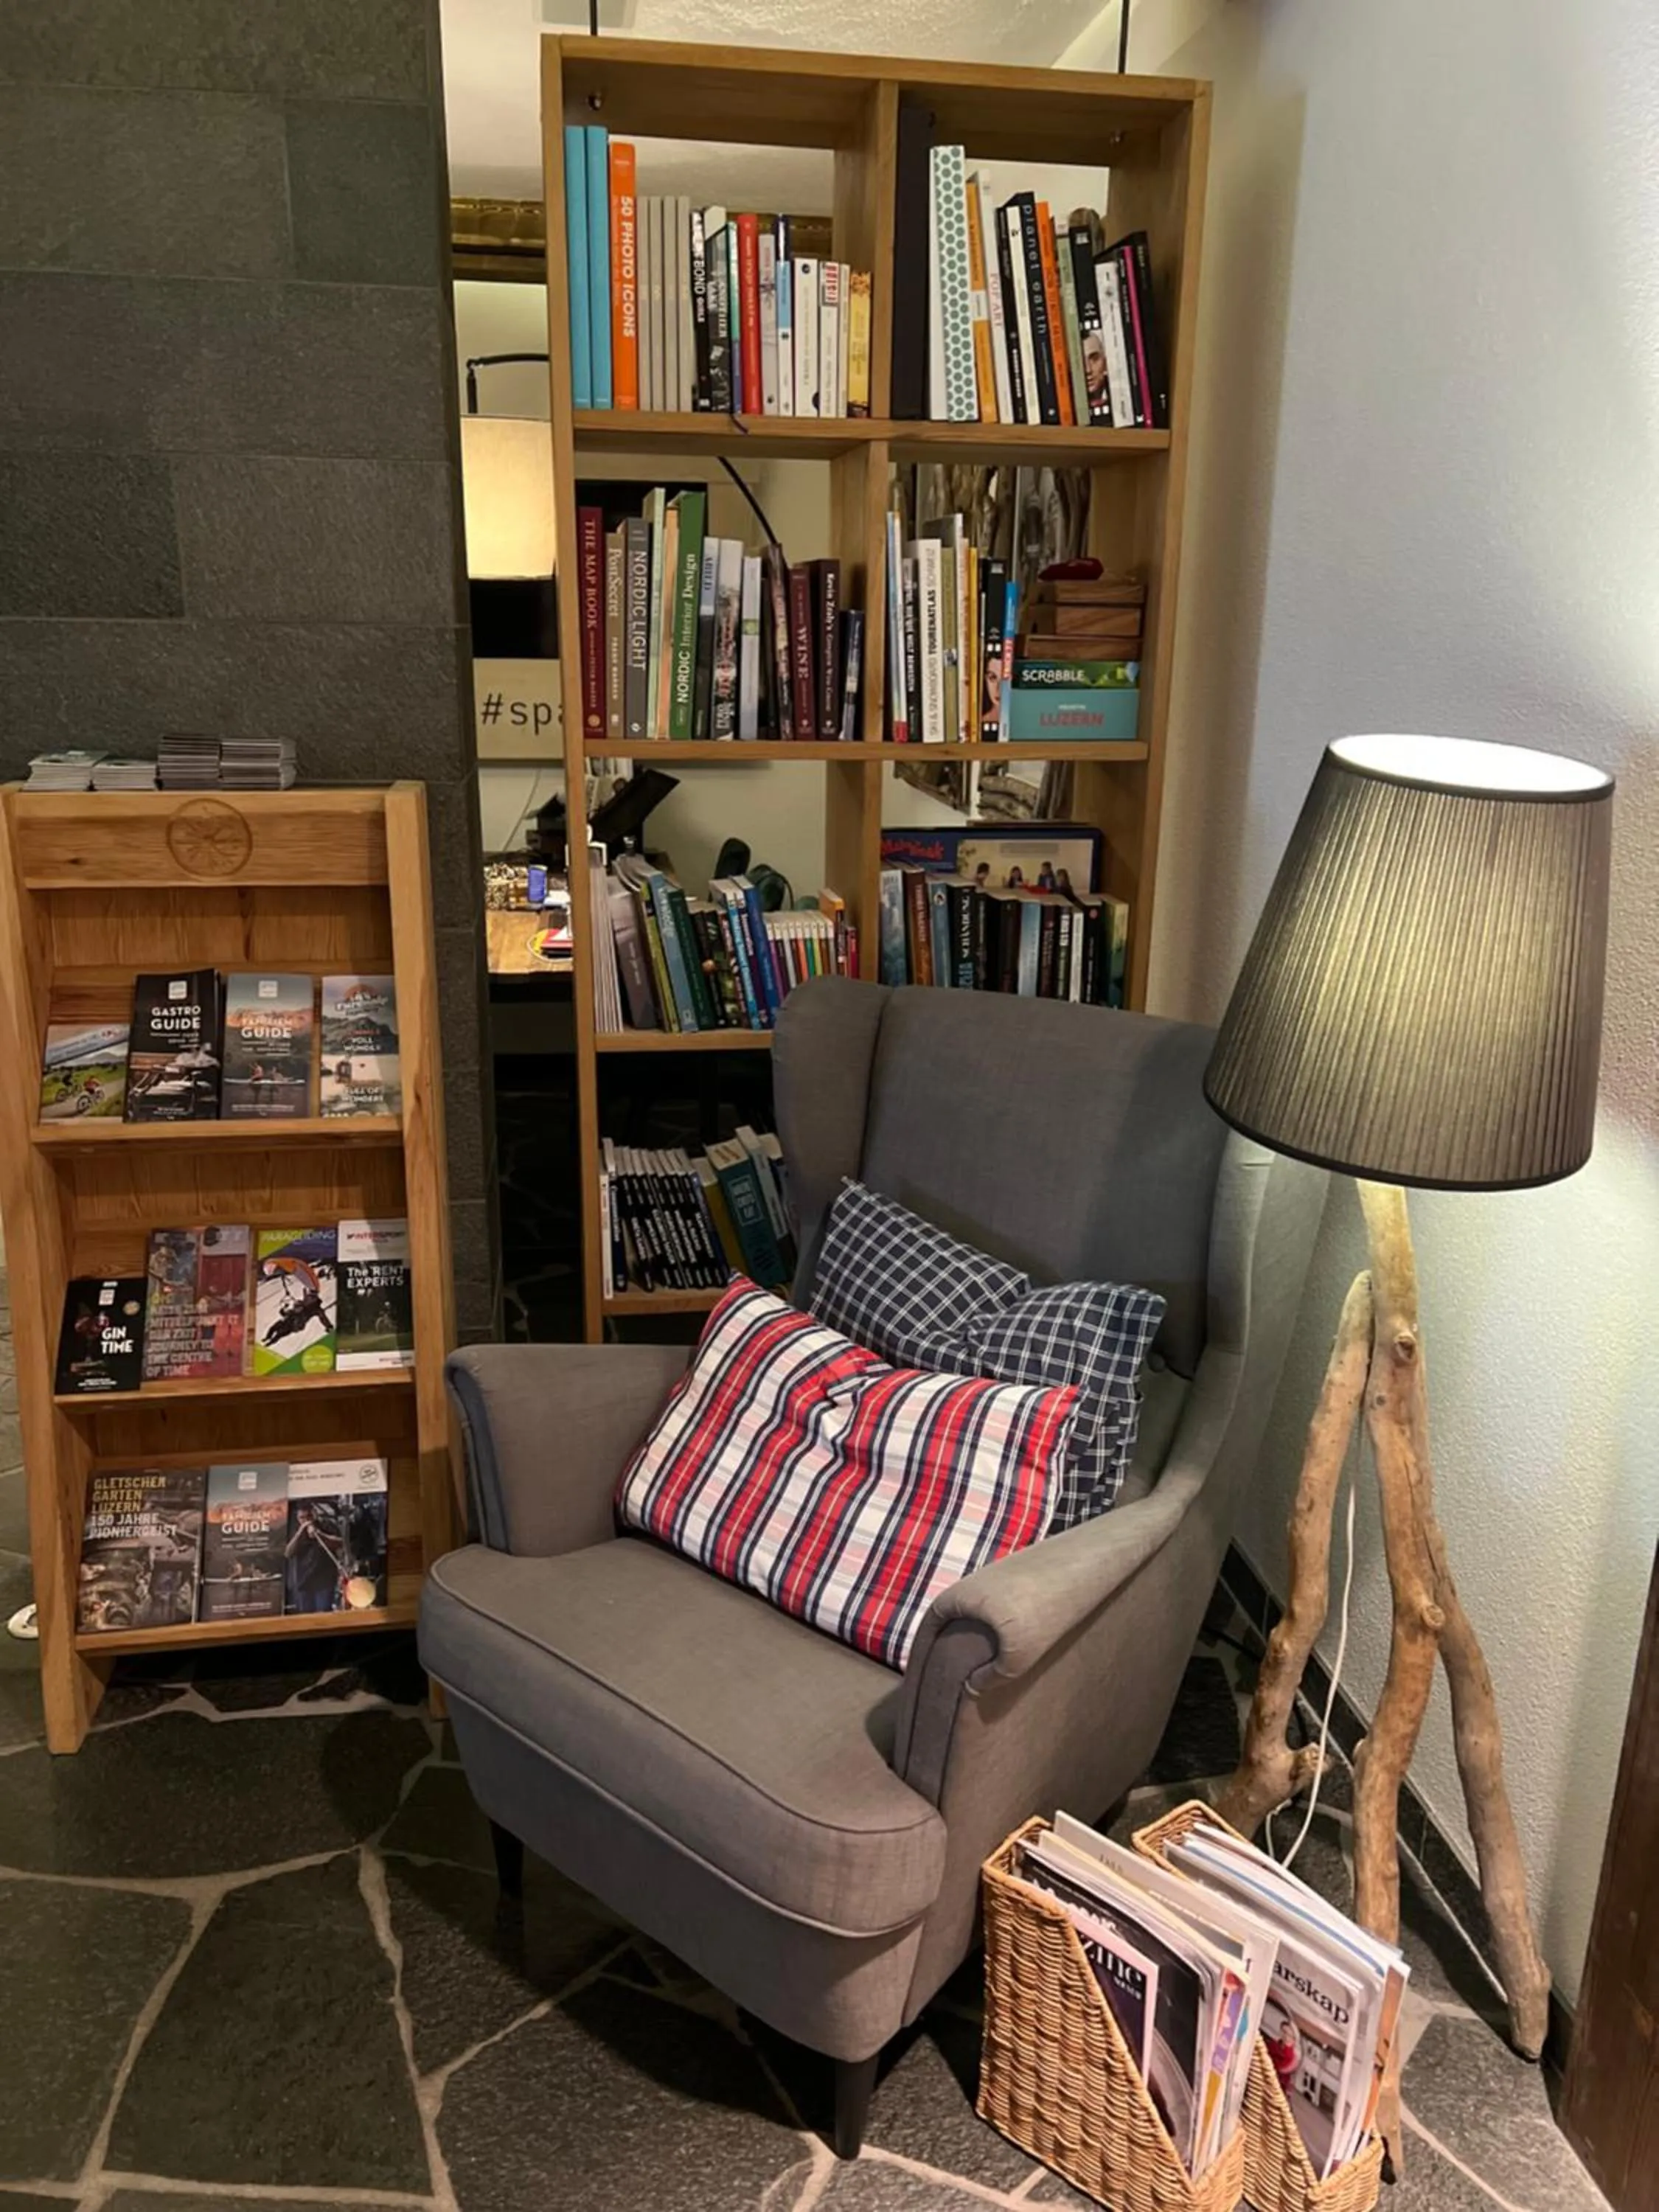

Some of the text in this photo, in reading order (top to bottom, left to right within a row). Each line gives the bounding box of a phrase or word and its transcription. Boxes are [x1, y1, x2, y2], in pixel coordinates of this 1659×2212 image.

[621, 197, 636, 337] 50 PHOTO ICONS
[1022, 204, 1048, 335] planet earth
[693, 261, 707, 296] BOND
[990, 273, 1004, 327] POP ART
[585, 521, 599, 629] THE MAP BOOK
[607, 548, 623, 617] PostSecret
[826, 572, 835, 599] Kevin
[632, 551, 647, 671] NORDIC LIGHT
[675, 553, 696, 703] NORDIC Interior Design
[927, 589, 937, 655] TOURENATLAS
[796, 626, 810, 678] WINE
[1022, 669, 1085, 684] SCRABBLE
[481, 693, 563, 735] #sp
[151, 1005, 201, 1018] GASTRO
[150, 1018, 201, 1030] GUIDE
[241, 1026, 293, 1039] GUIDE
[347, 1265, 405, 1277] The RENT
[347, 1276, 404, 1289] EXPERTS
[102, 1326, 127, 1340] GIN
[100, 1340, 133, 1354] TIME
[94, 1476, 167, 1489] GLETSCHER
[92, 1489, 142, 1502] GARTEN
[91, 1501, 141, 1514] LUZERN
[116, 1513, 159, 1526] JAHRE
[221, 1520, 270, 1534] GUIDE
